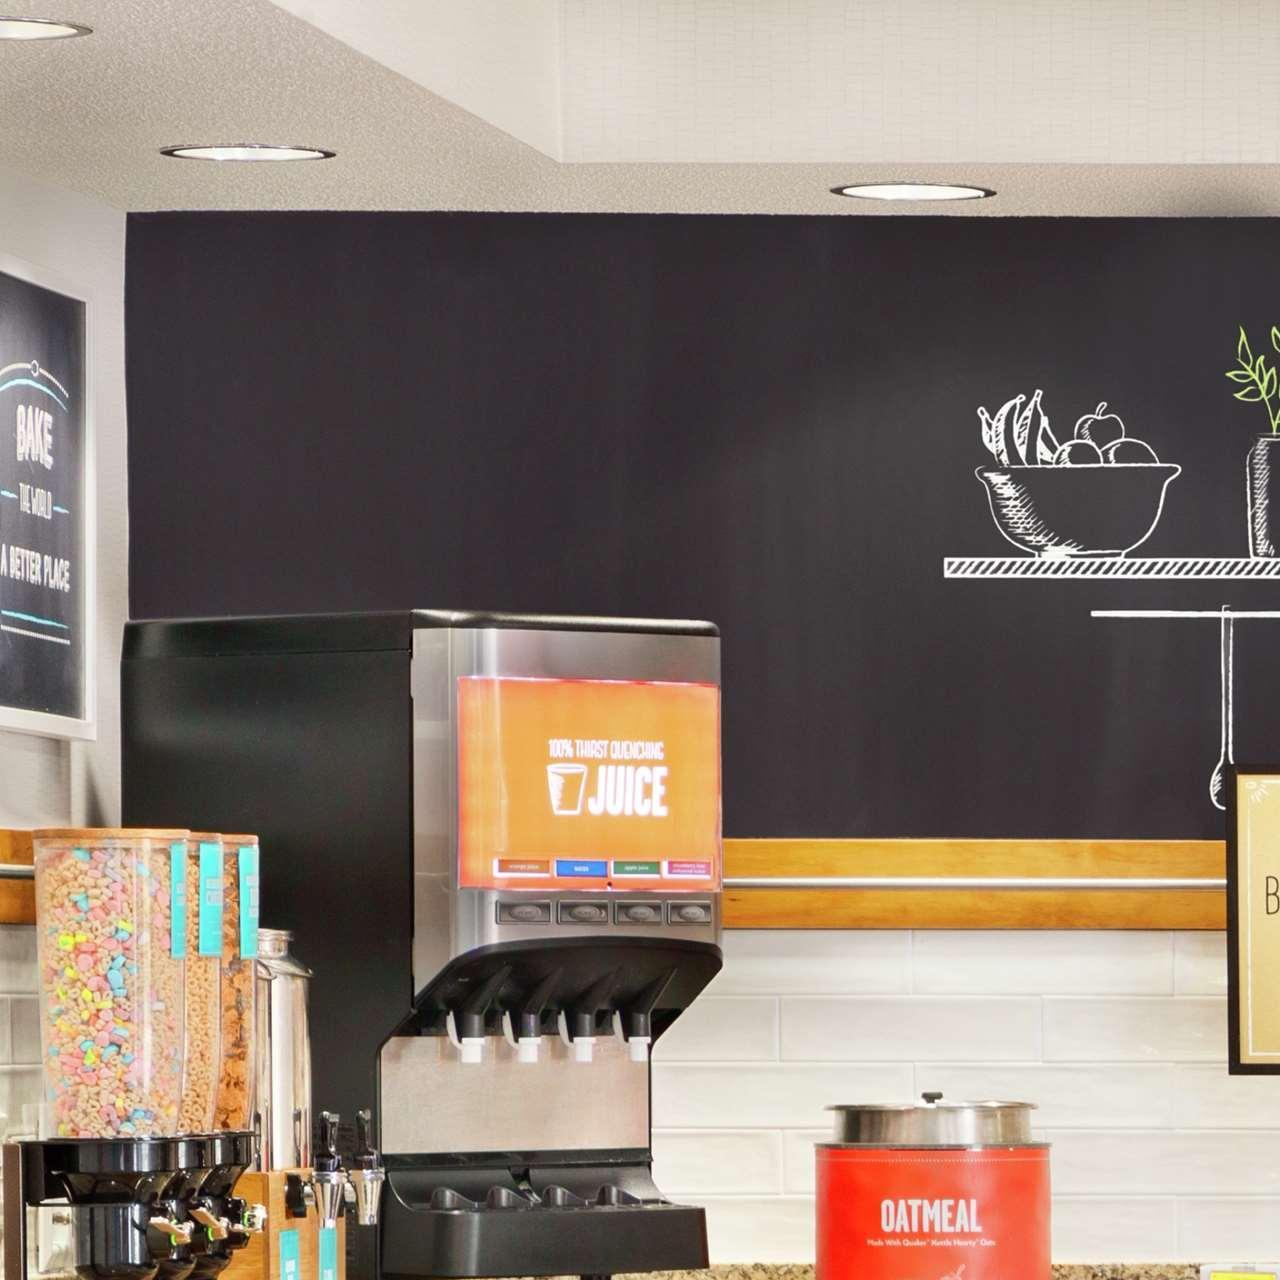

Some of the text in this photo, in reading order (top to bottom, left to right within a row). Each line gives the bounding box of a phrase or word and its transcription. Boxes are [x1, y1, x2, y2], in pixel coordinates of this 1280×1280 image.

[16, 404, 54, 470] BAKE
[0, 543, 71, 593] A BETTER PLACE
[548, 738, 574, 759] 100%
[575, 739, 609, 759] THIRST
[588, 764, 669, 817] JUICE
[881, 1199, 982, 1233] OATMEAL
